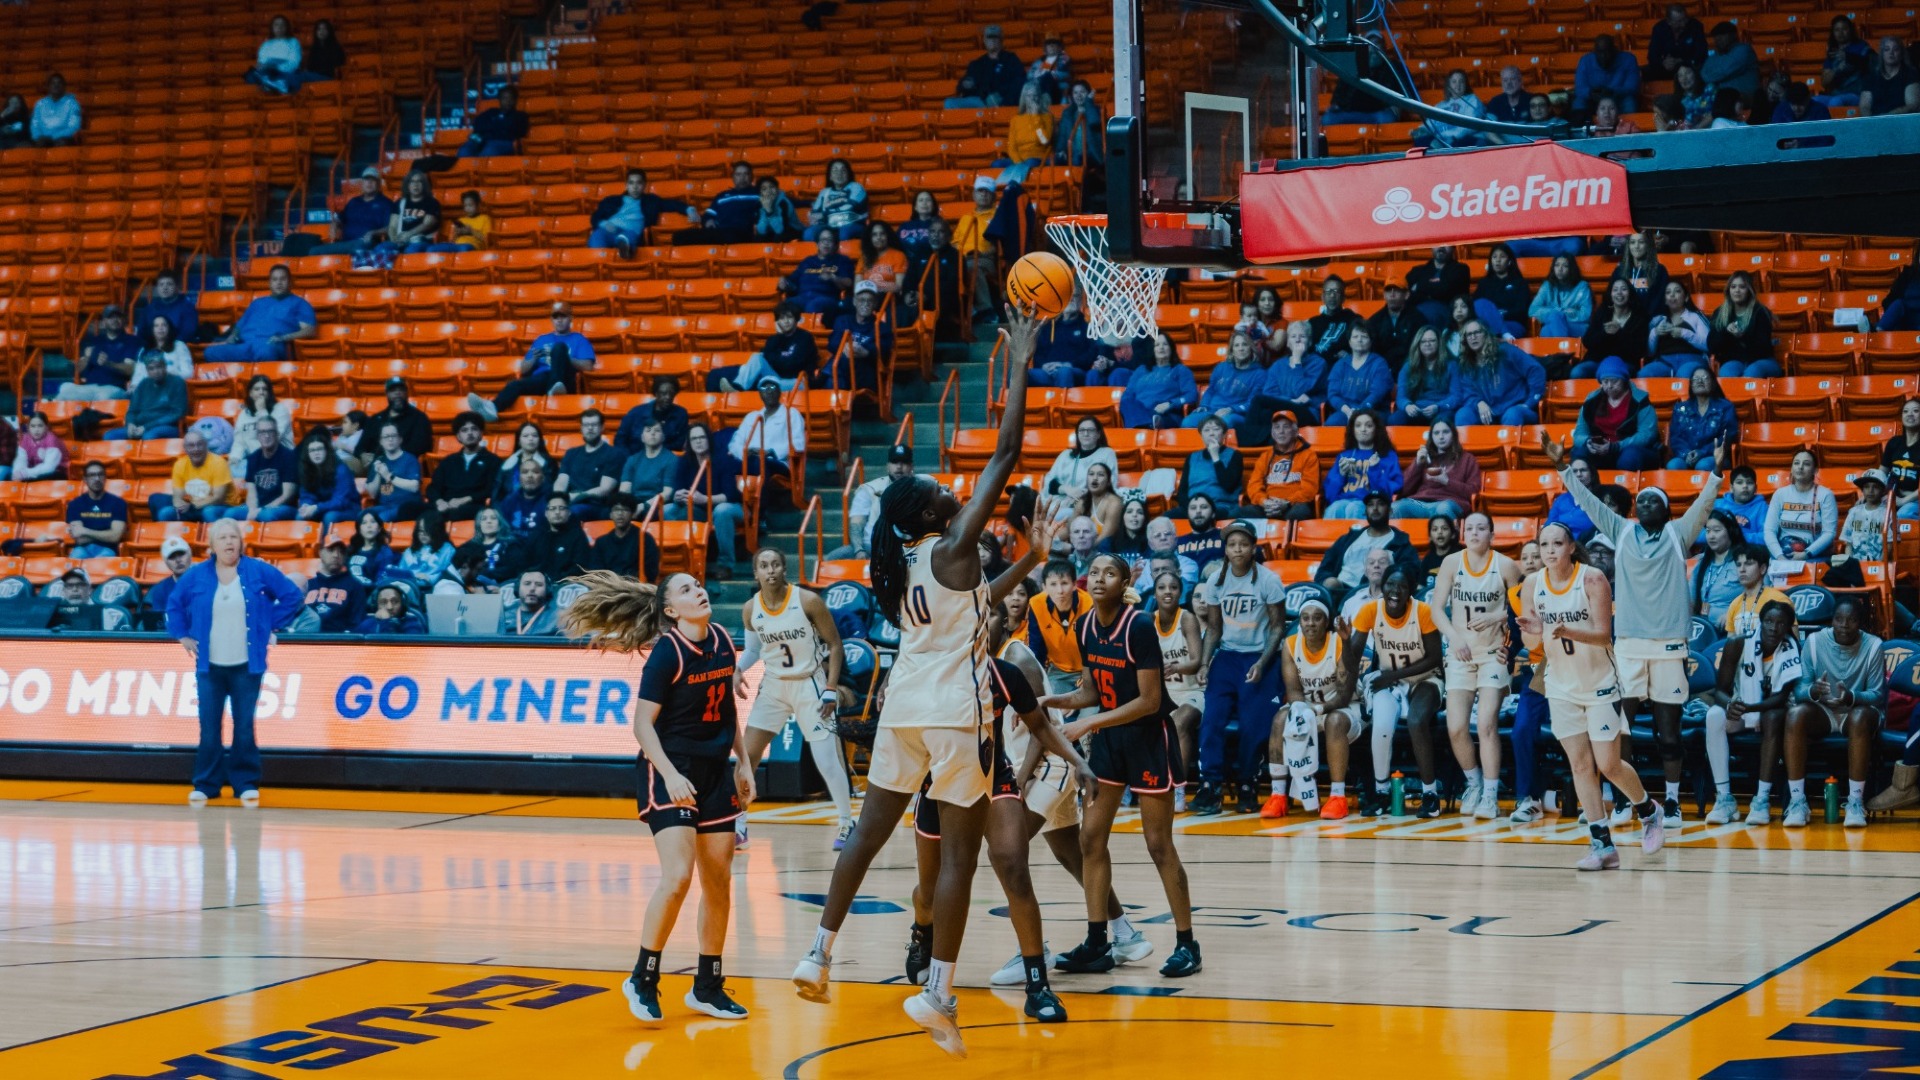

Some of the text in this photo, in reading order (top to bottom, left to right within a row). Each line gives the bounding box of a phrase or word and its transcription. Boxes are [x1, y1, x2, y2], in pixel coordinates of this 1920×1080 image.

[1428, 174, 1612, 220] State Farm
[1901, 524, 1910, 532] 14
[1869, 566, 1879, 574] 14
[304, 587, 348, 605] UTEP
[457, 600, 468, 616] hp
[1222, 592, 1258, 620] UTEP
[780, 643, 794, 668] 3
[687, 674, 707, 685] SAM
[1092, 668, 1118, 711] 15
[0, 667, 302, 720] O MINES!
[335, 675, 632, 725] GO MINER
[702, 682, 726, 722] 11
